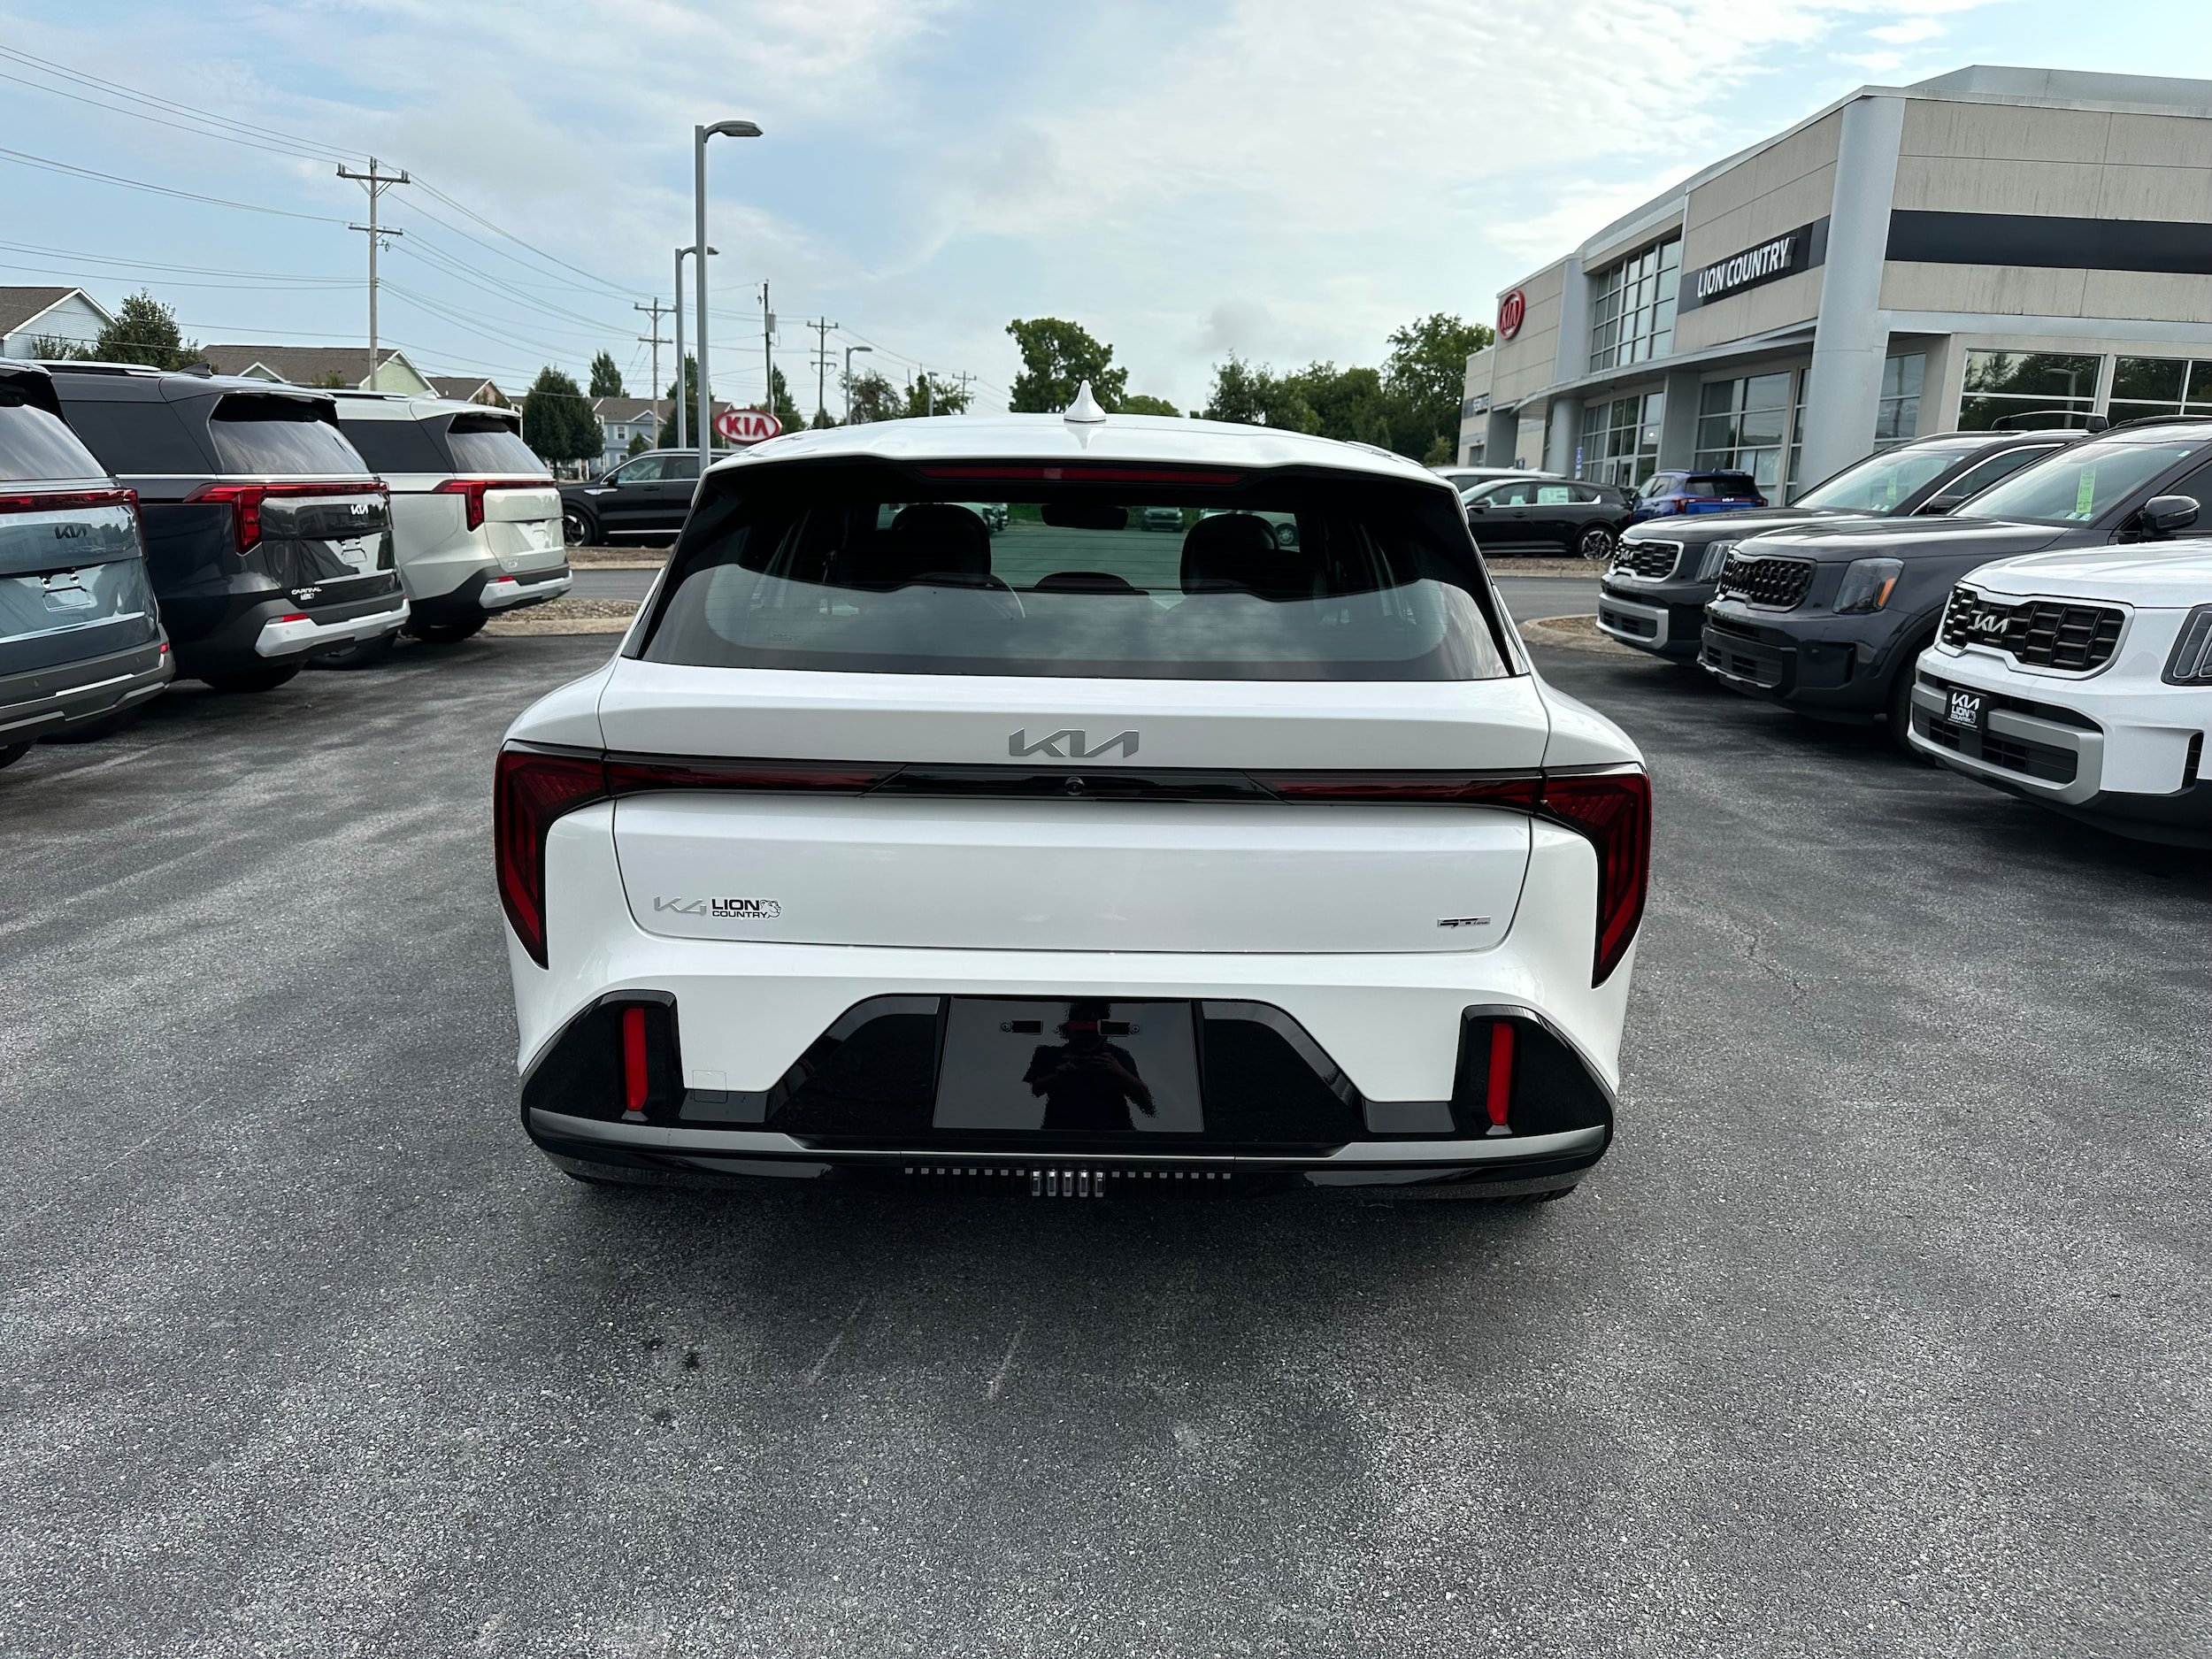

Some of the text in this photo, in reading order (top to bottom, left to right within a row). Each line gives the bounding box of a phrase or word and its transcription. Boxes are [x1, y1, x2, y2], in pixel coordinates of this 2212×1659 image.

[1697, 237, 1790, 297] LION COUNTRY
[1500, 300, 1521, 330] KIA
[726, 416, 769, 437] KIA
[350, 504, 368, 514] KIA
[55, 525, 87, 539] KIA
[1974, 615, 2010, 634] KIA
[1952, 692, 1980, 710] KIA
[1951, 704, 1970, 718] LION
[1009, 727, 1139, 758] KIA
[654, 895, 707, 916] K4
[711, 898, 760, 911] LION
